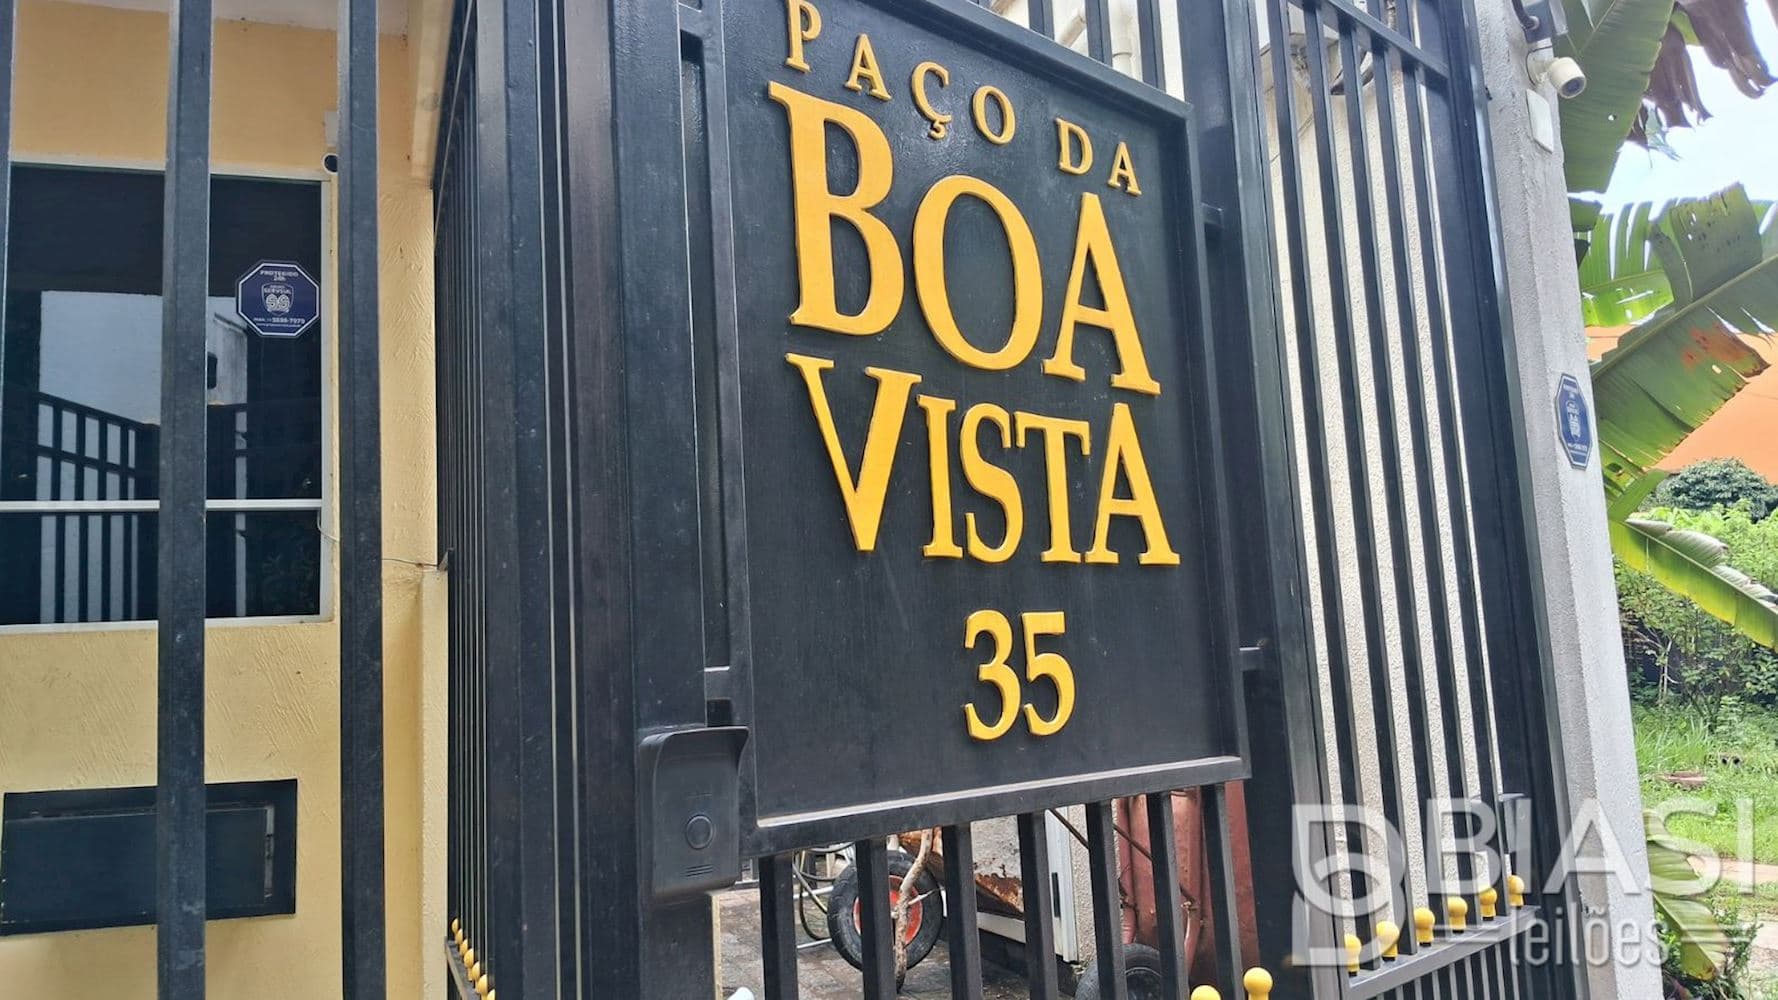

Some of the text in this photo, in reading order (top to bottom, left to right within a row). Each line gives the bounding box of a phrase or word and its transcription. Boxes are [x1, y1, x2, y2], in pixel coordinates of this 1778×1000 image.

[785, 0, 1142, 197] PAÇO DA
[768, 80, 1162, 398] BOA
[786, 352, 1182, 567] VISTA
[963, 609, 1076, 742] 35
